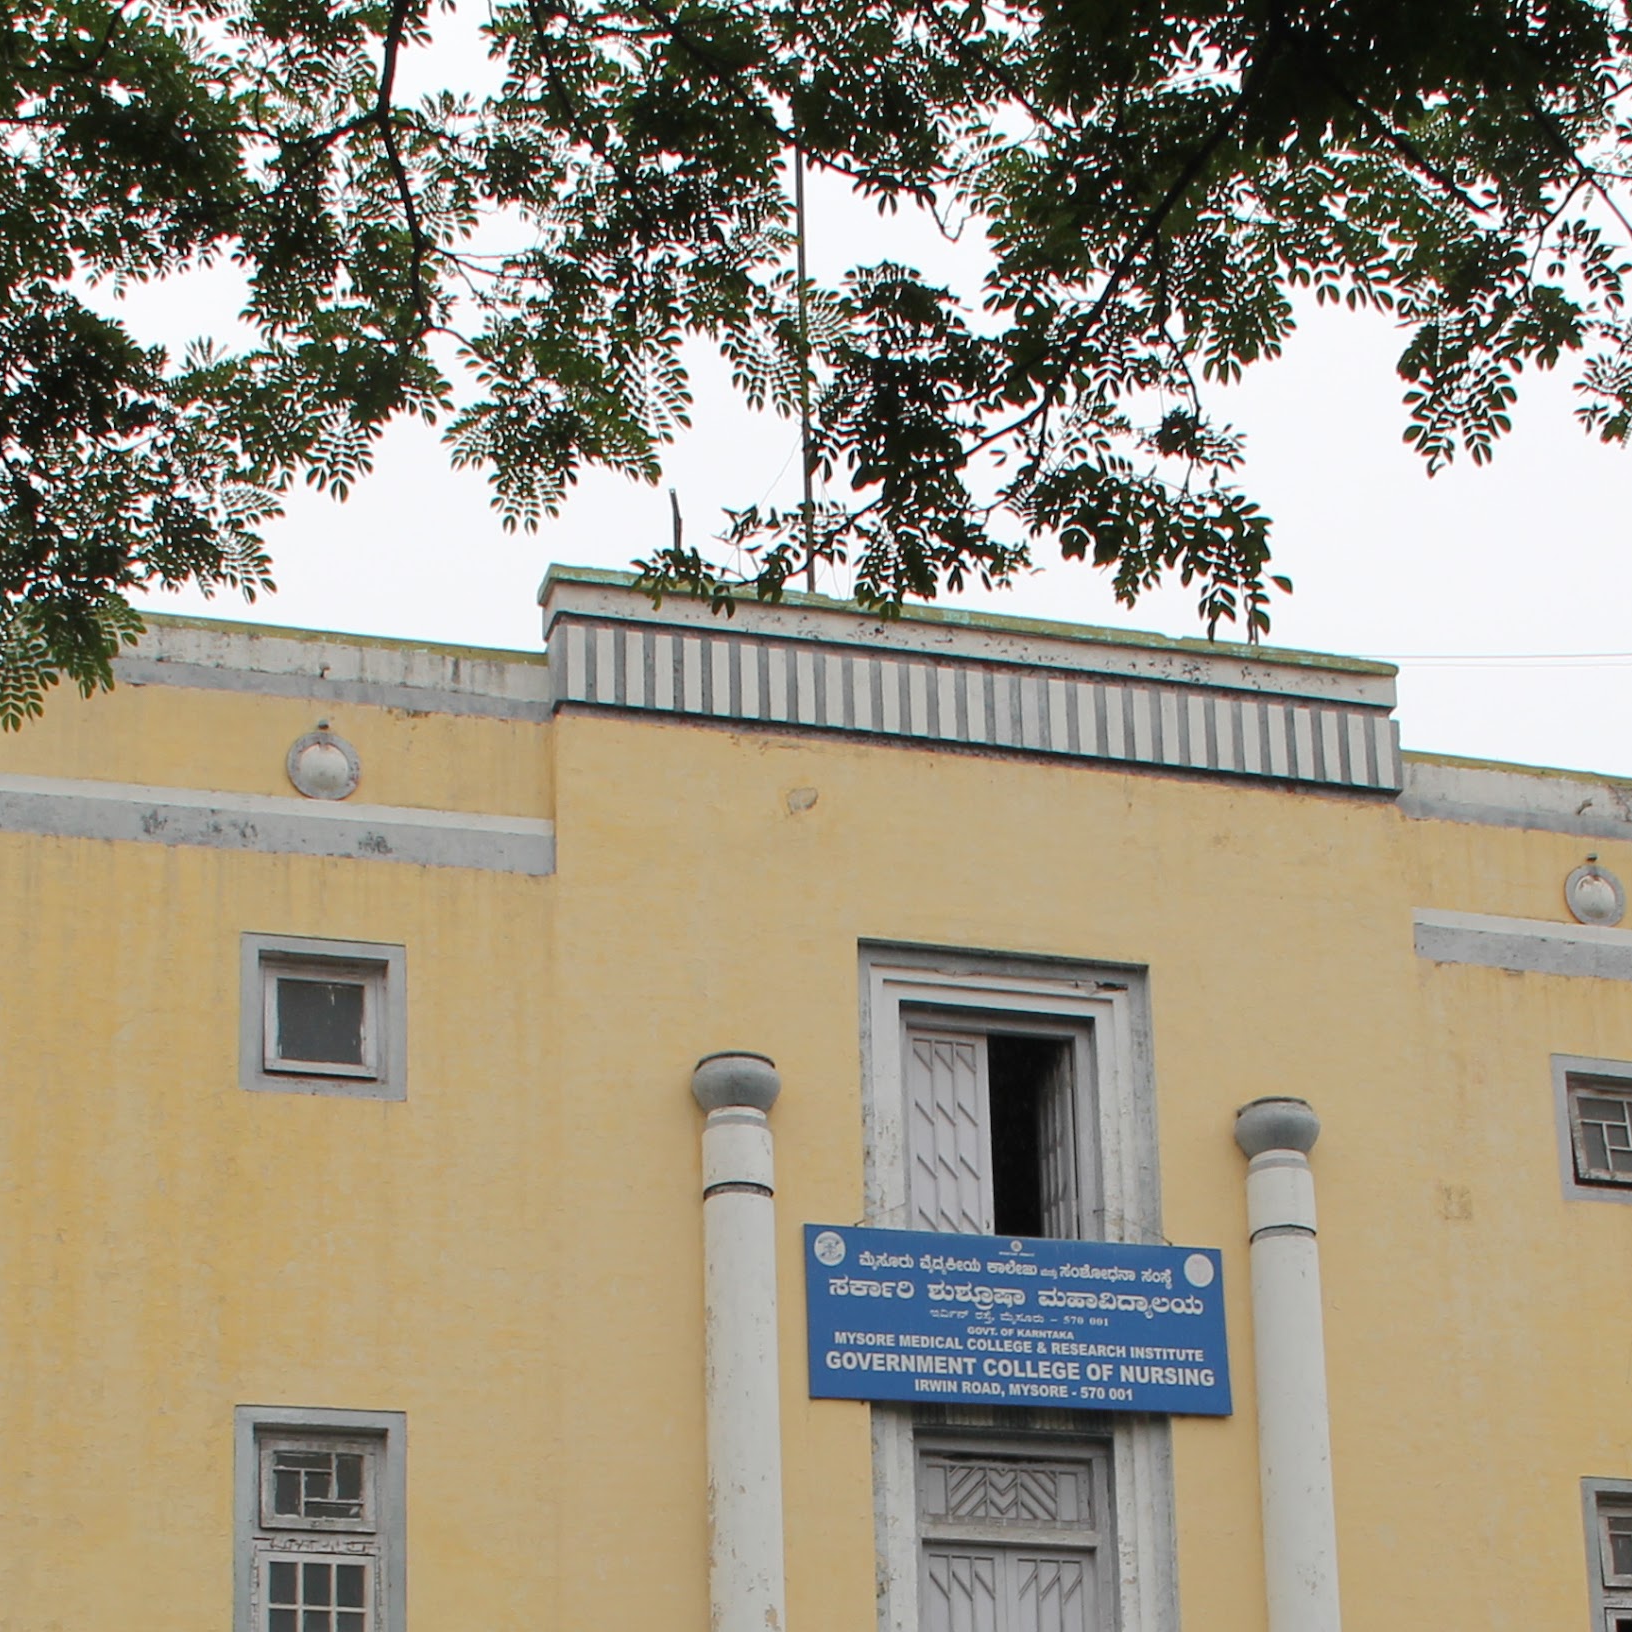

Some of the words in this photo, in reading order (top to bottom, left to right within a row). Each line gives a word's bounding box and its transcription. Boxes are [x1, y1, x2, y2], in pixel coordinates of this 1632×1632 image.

[859, 1251, 914, 1271] ಮೈಸೂರು
[920, 1254, 981, 1275] ವೈದ್ಯಕೀಯ
[987, 1260, 1038, 1276] ಕಾಲೇಜು
[1059, 1263, 1136, 1283] ಸಂಶೋಧನಾ
[829, 1274, 915, 1299] ಸರ್ಕಾರಿ
[1037, 1286, 1204, 1319] ಮಹಾವಿದ್ಯಾಲಯ
[967, 1326, 998, 1336] GOVT.
[1000, 1328, 1015, 1337] OF
[1017, 1329, 1075, 1340] KARNTAKA
[1063, 1315, 1084, 1325] 570
[1089, 1317, 1109, 1327] 001
[834, 1331, 895, 1347] MYSORE
[899, 1334, 963, 1349] MEDICAL
[967, 1338, 1032, 1353] COLLEGE
[1036, 1341, 1047, 1354] &
[1051, 1342, 1126, 1358] RESEARCH
[1130, 1346, 1204, 1362] INSTITUTE
[826, 1351, 977, 1375] GOVERNMENT
[983, 1357, 1081, 1380] COLLEGE
[1086, 1363, 1114, 1382] OF
[1120, 1365, 1215, 1386] NURSING
[914, 1379, 958, 1393] IRWIN
[962, 1381, 1005, 1397] ROAD,
[1009, 1383, 1068, 1398] MYSORE
[1080, 1386, 1105, 1400] 570
[1108, 1387, 1134, 1401] 001
